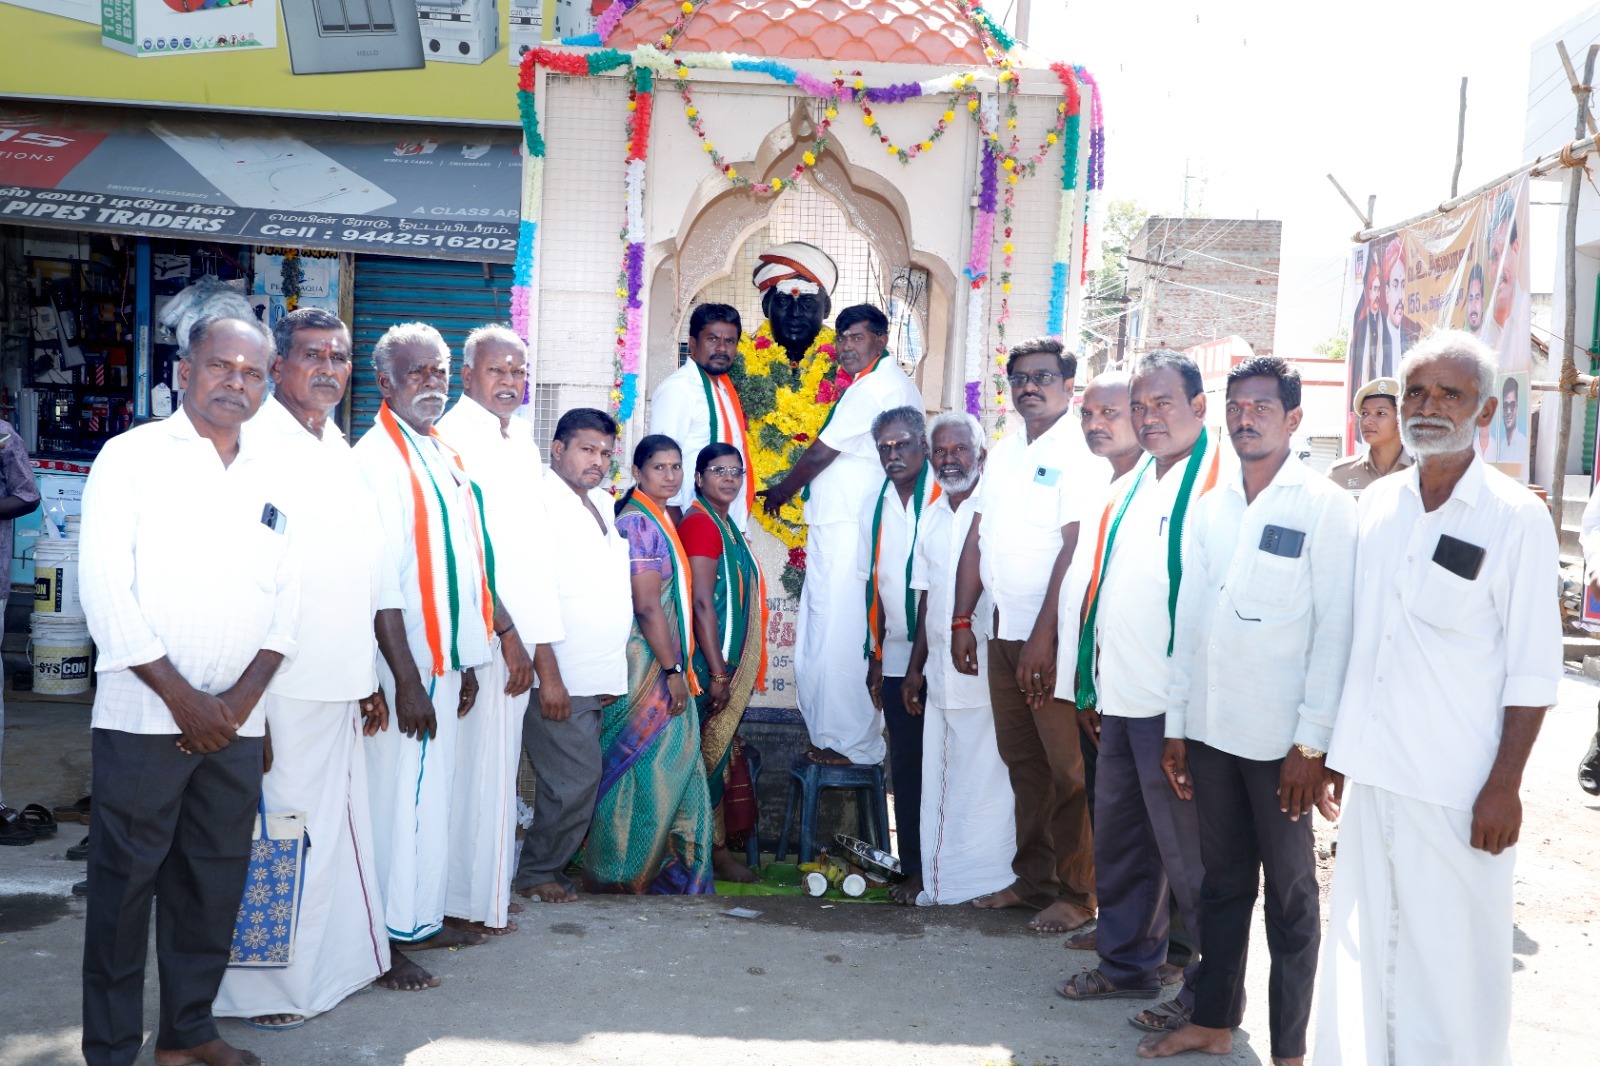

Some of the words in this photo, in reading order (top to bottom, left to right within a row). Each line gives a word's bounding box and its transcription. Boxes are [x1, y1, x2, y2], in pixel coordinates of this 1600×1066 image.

[2, 200, 91, 221] PIPES
[96, 208, 226, 232] TRADERS
[412, 206, 425, 214] A
[430, 207, 490, 216] CLASS
[259, 223, 317, 239] Cell
[341, 228, 517, 252] 9442516202
